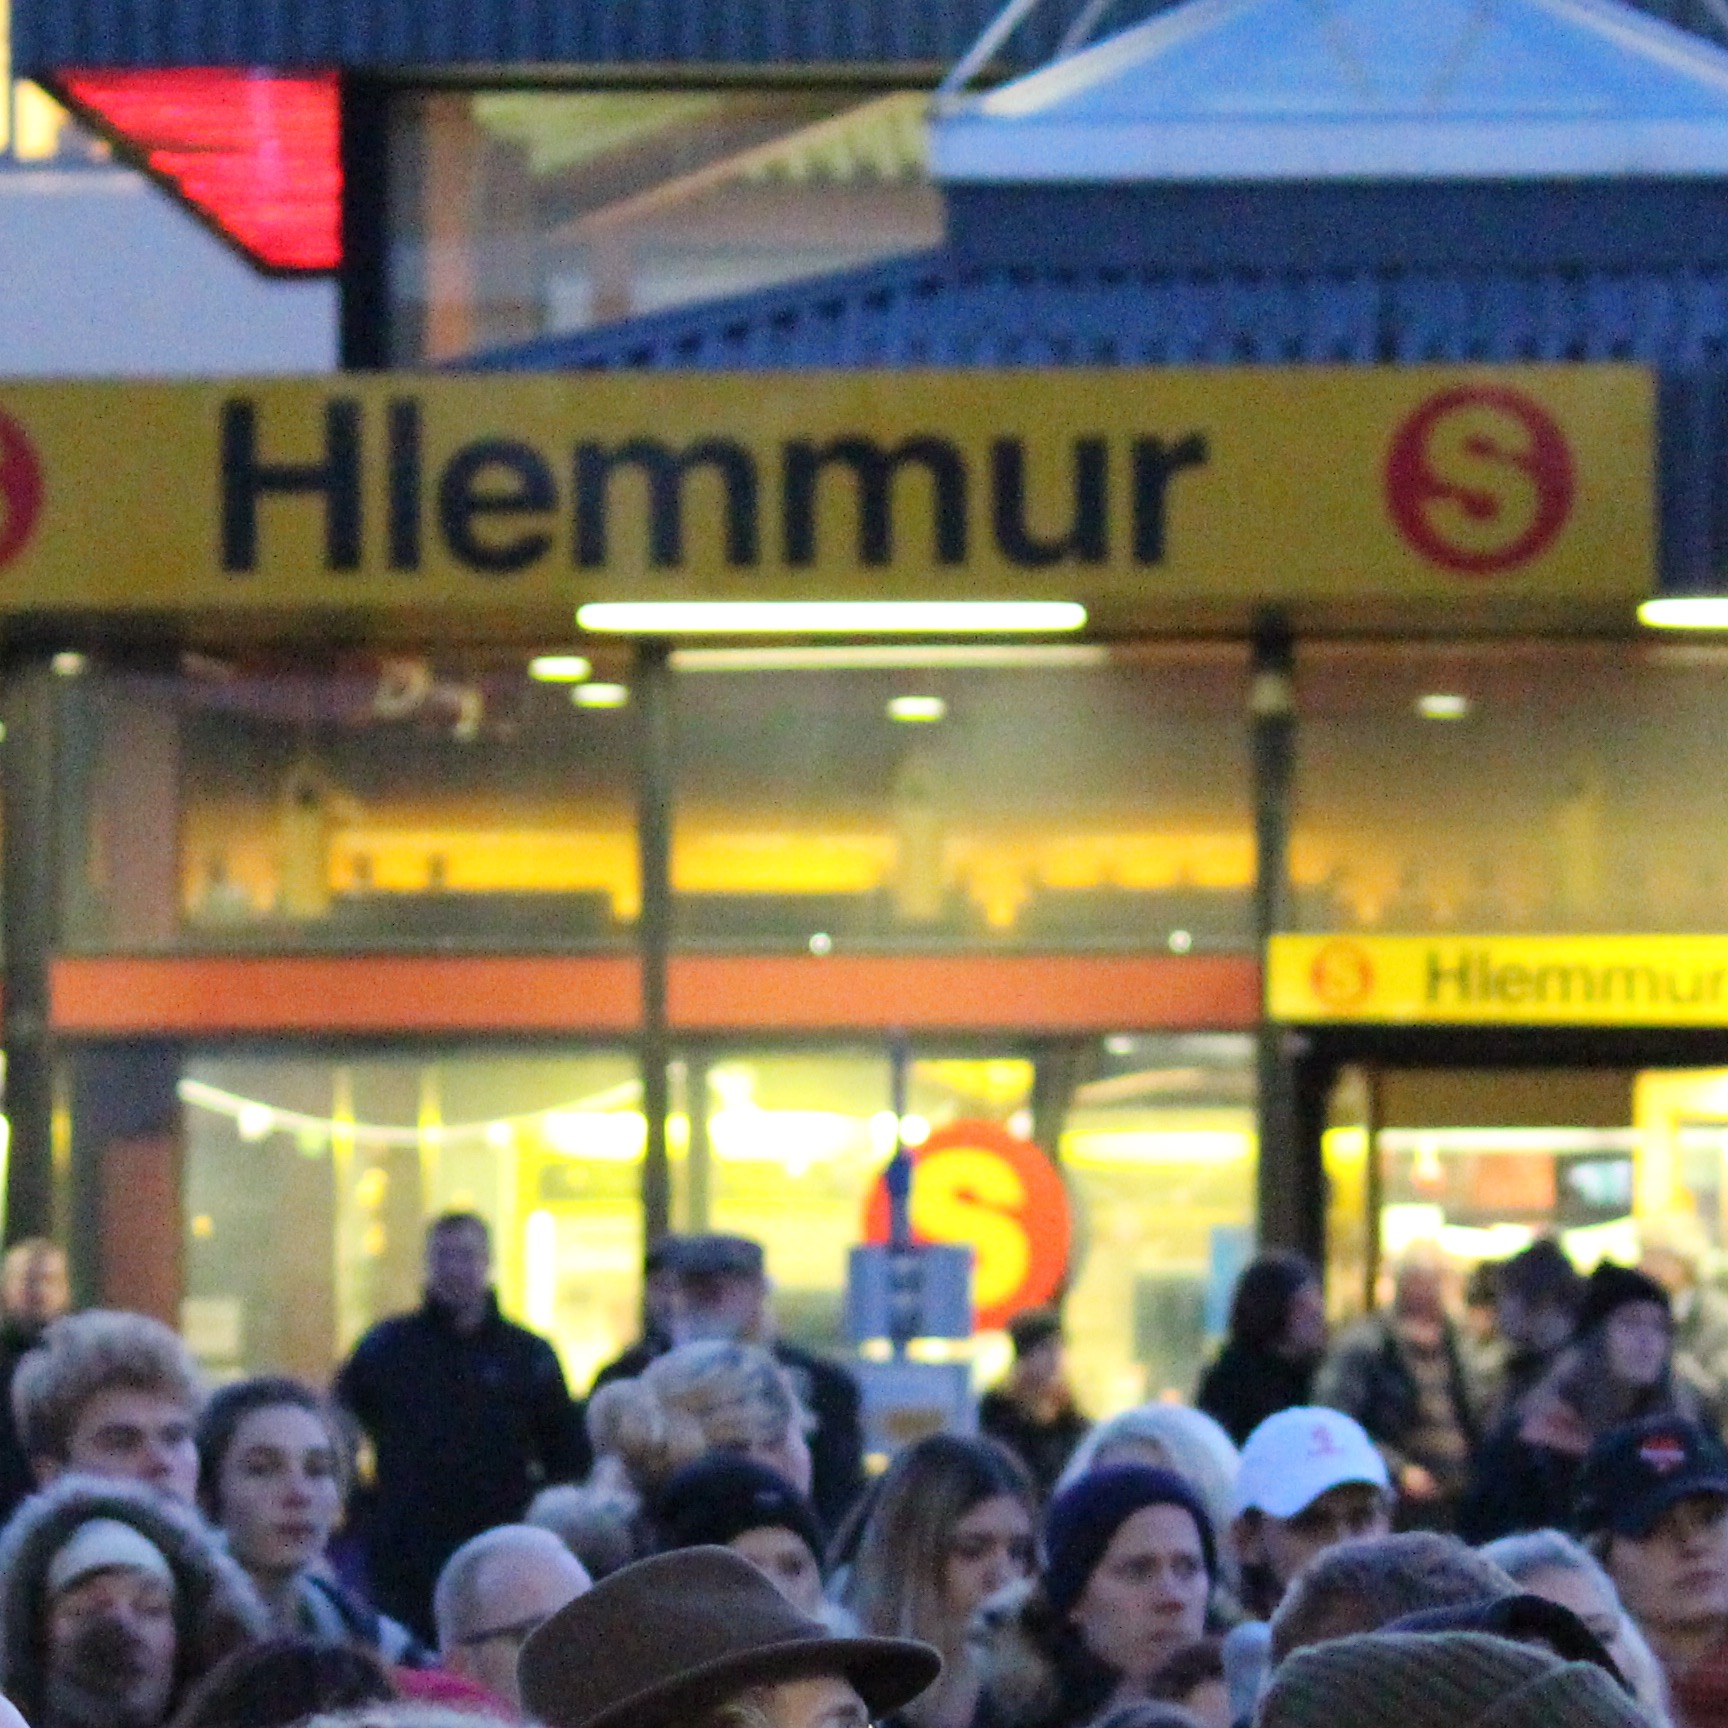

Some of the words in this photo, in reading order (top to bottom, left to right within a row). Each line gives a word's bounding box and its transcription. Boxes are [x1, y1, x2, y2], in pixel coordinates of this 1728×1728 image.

[215, 394, 1210, 579] Hlemmur
[1426, 406, 1539, 555] S
[1426, 950, 1725, 1005] Hlemmur
